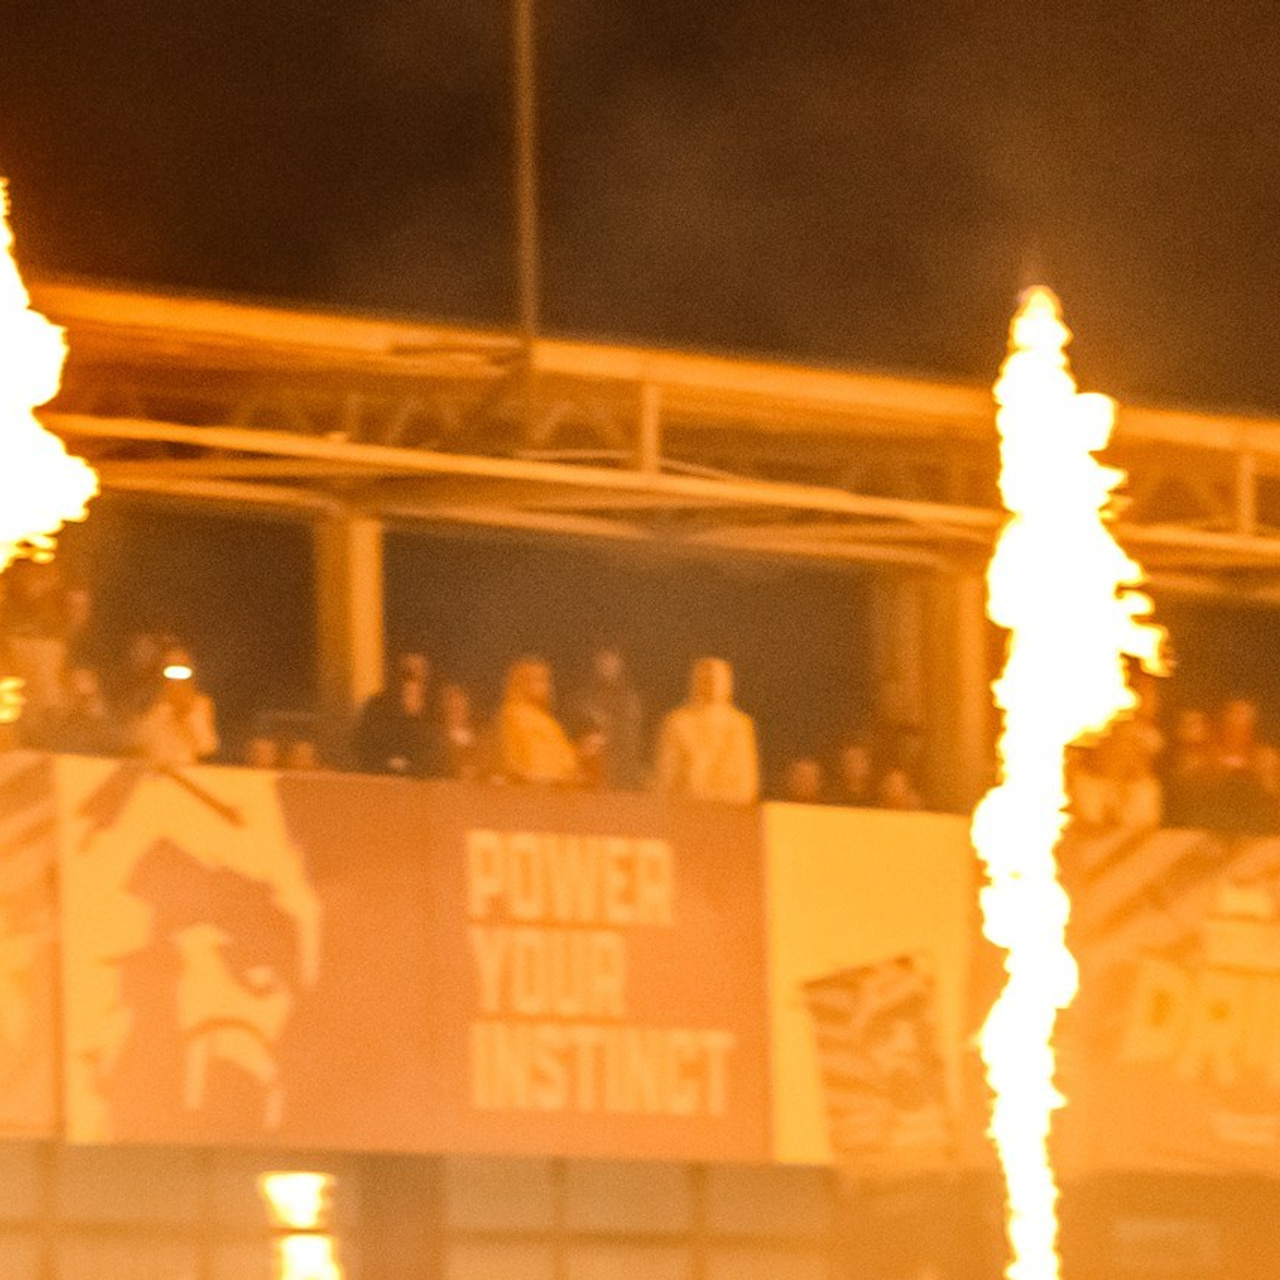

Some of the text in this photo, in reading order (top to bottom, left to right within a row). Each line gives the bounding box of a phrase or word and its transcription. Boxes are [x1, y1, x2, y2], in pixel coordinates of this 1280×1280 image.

[467, 831, 674, 926] POWER
[469, 925, 627, 1017] YOUR
[472, 1023, 736, 1114] INSTINCT
